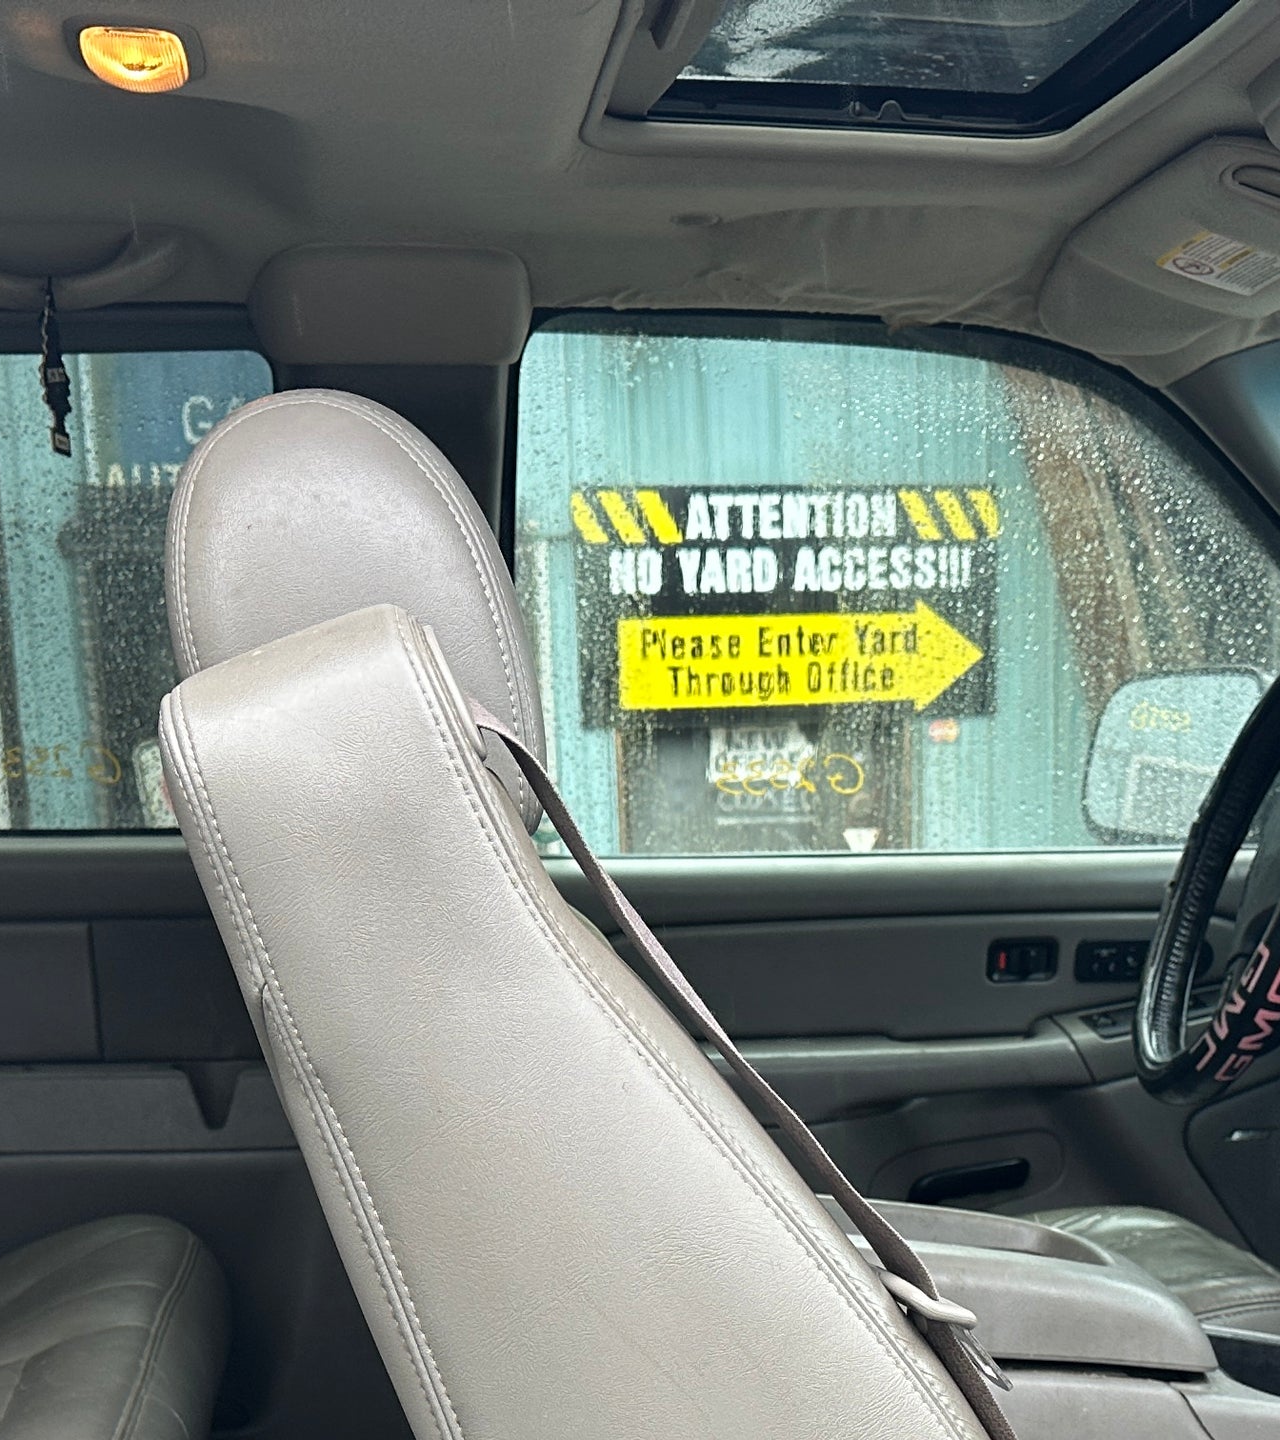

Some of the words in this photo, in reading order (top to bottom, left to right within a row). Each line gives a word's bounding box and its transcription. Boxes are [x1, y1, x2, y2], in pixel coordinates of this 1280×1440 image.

[686, 491, 898, 541] ATTENTION
[609, 547, 664, 595] NO
[676, 546, 778, 594] YARD
[792, 545, 972, 592] ACCESS!!!
[640, 627, 741, 661] Please
[757, 626, 839, 658] Enter
[855, 620, 919, 655] Yard
[667, 664, 791, 701] Through
[807, 661, 895, 694] Office
